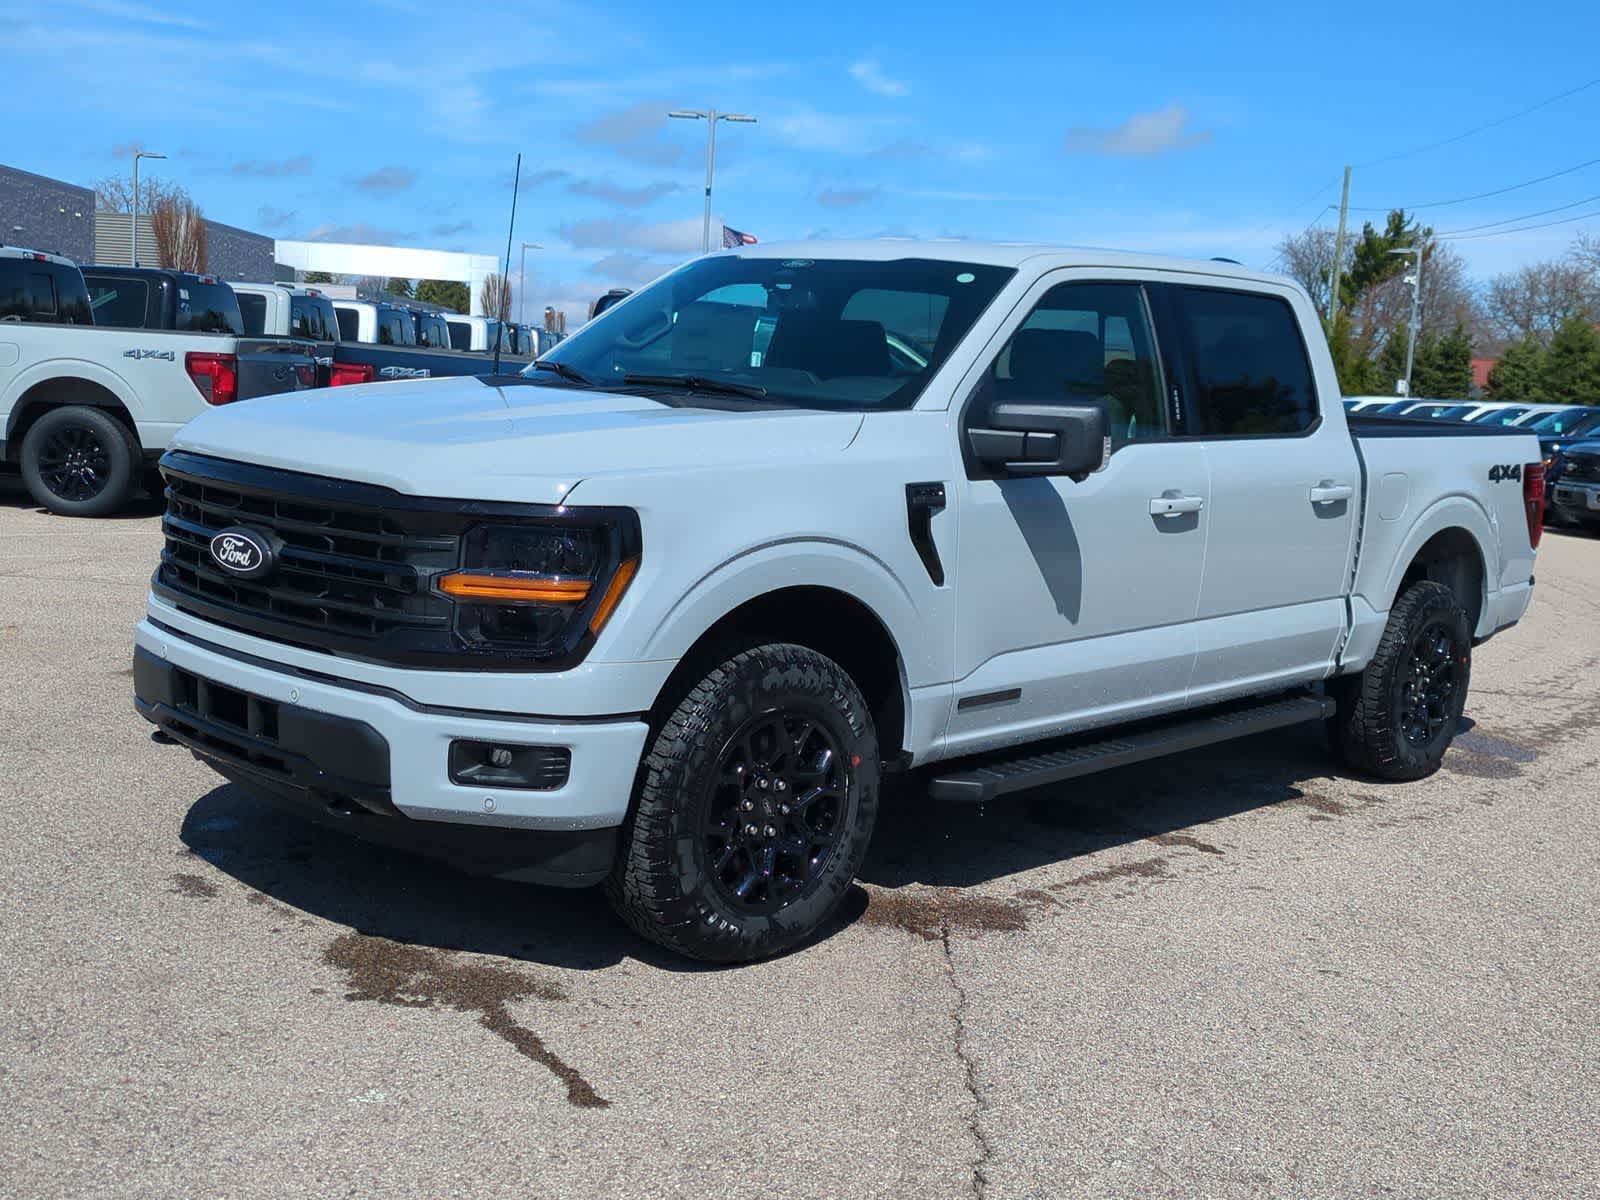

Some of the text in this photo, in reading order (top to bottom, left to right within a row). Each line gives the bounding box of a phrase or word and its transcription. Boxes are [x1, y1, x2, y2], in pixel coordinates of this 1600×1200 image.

[123, 348, 175, 361] 4X4
[1488, 464, 1521, 483] 4X4
[219, 537, 252, 566] Ford
